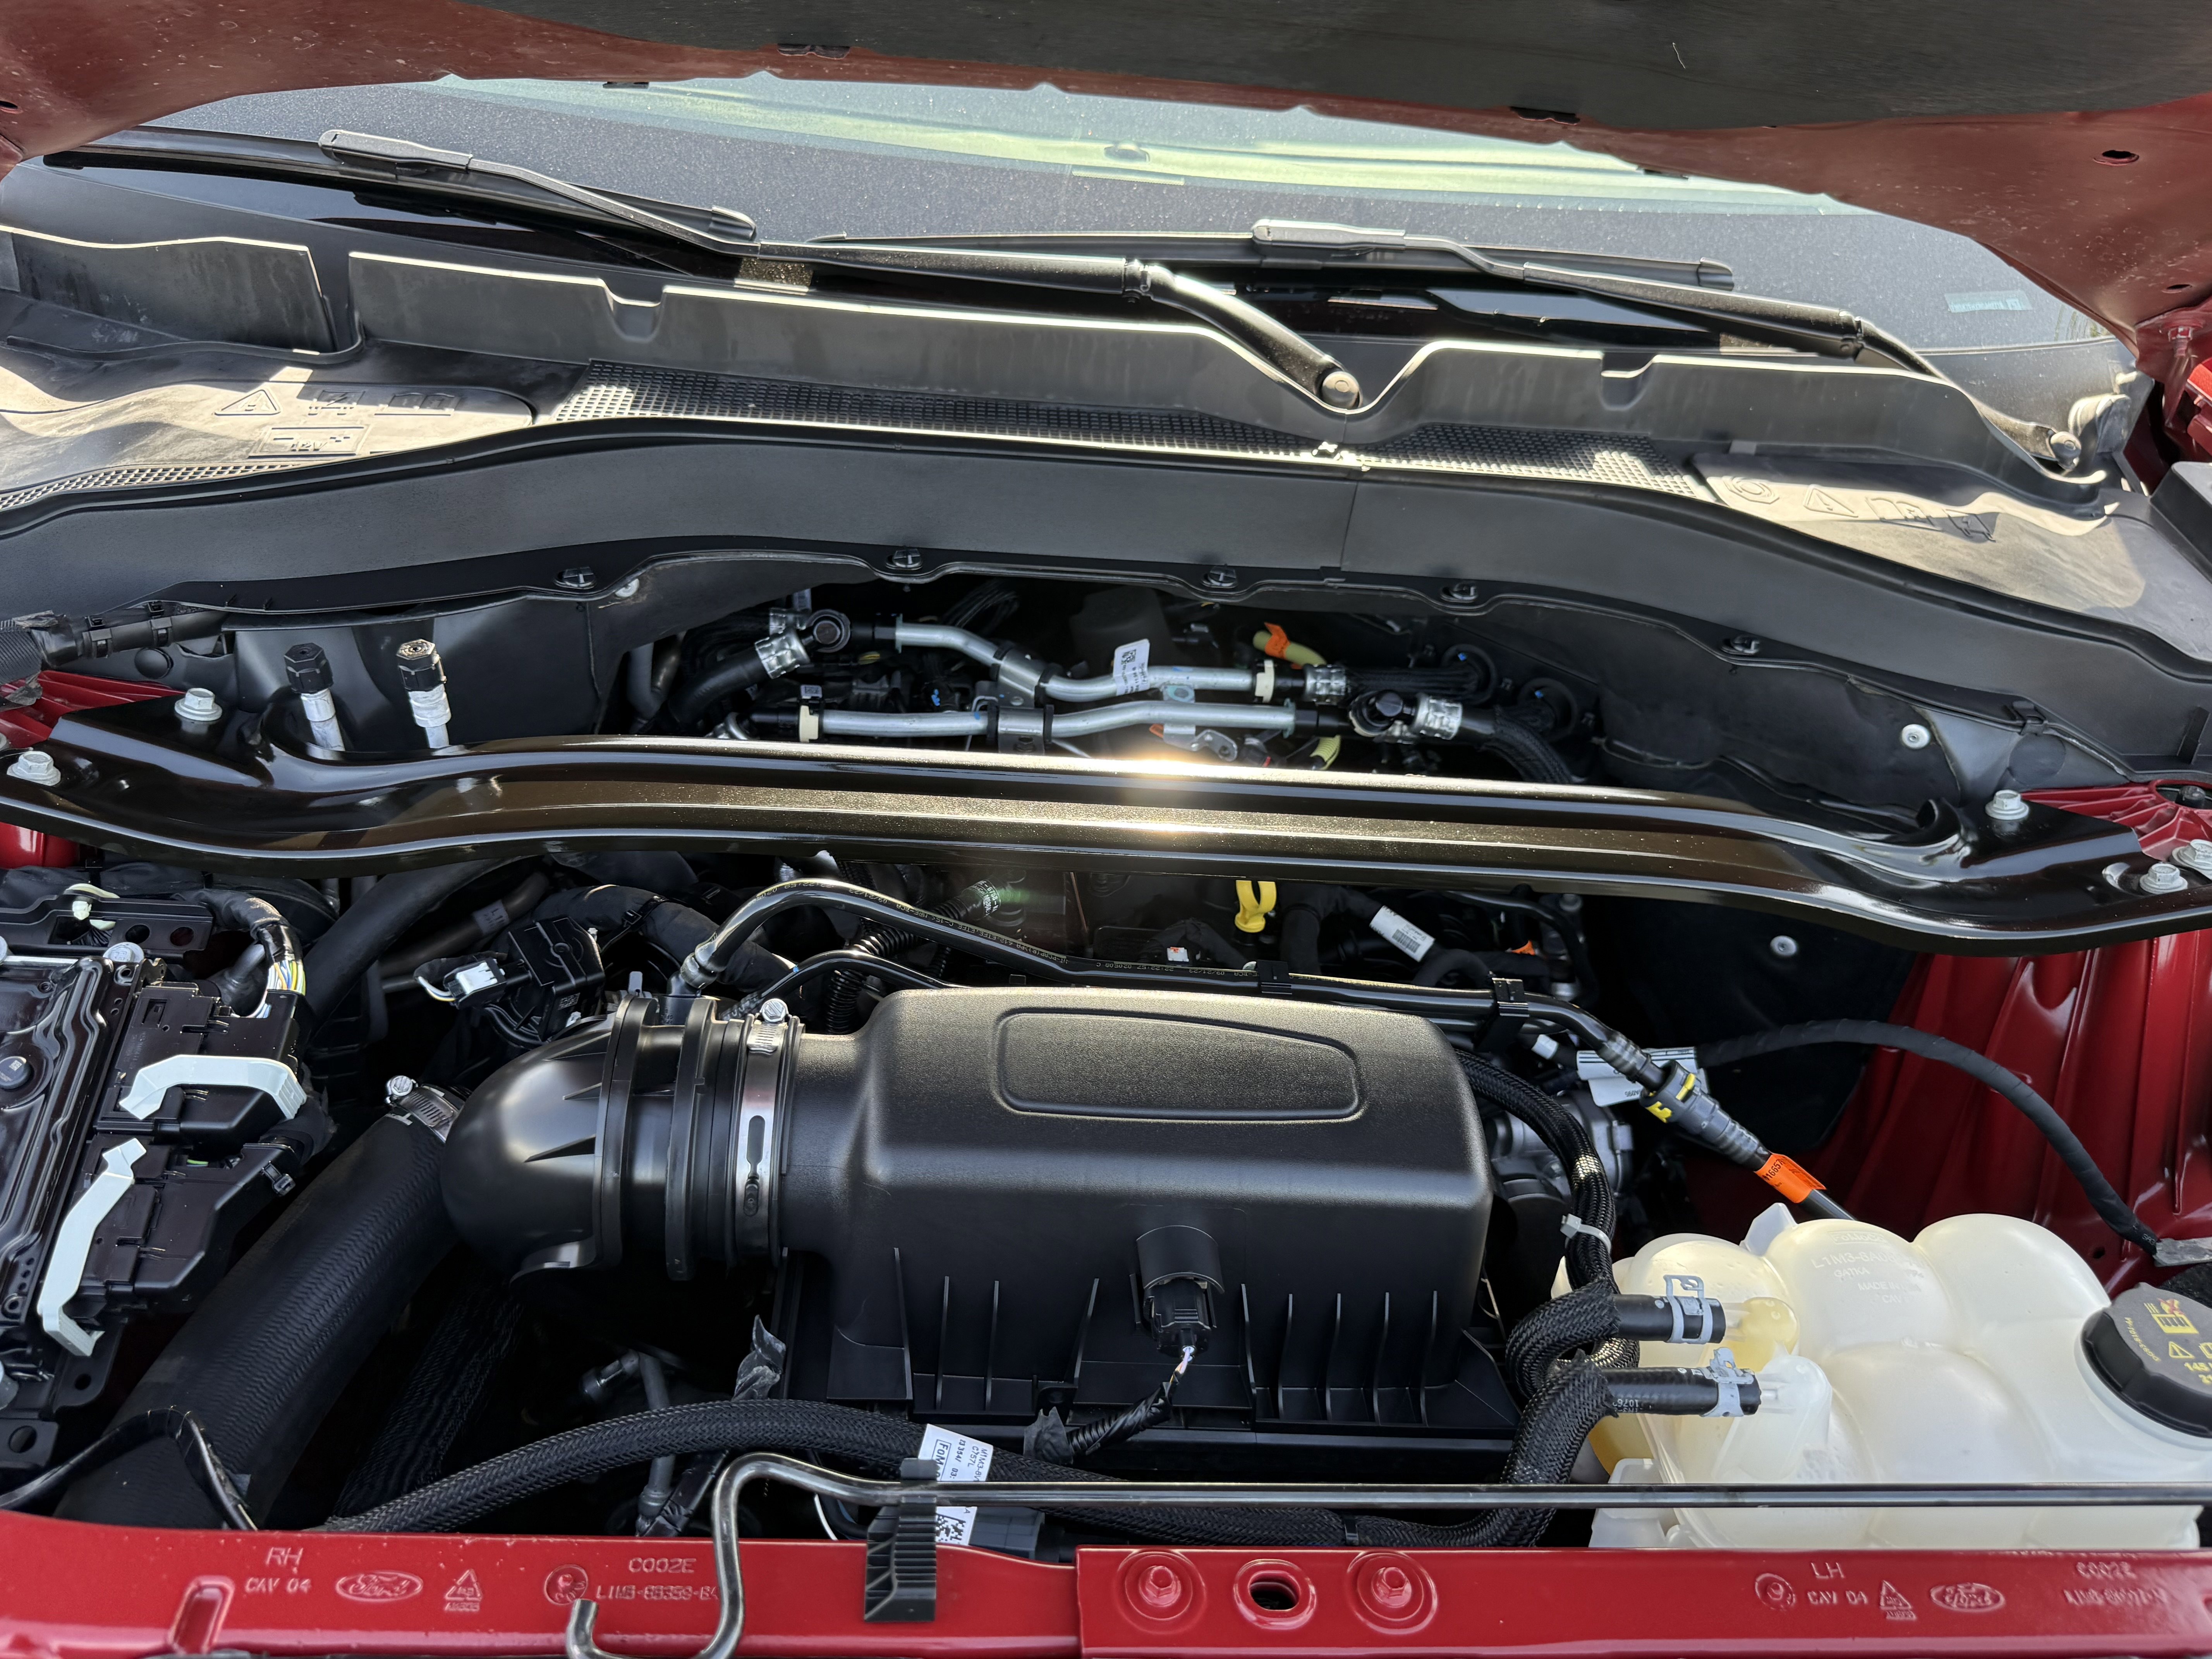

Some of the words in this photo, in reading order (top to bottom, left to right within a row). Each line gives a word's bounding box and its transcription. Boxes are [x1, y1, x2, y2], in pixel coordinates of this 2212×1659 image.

[1858, 1281, 1886, 1291] MADE
[967, 1446, 981, 1467] C757L
[265, 1547, 303, 1566] RH
[629, 1557, 697, 1573] C002E
[1810, 1562, 1845, 1579] LH
[245, 1577, 280, 1593] CAV
[287, 1578, 311, 1594] 04
[347, 1572, 412, 1598] Ford
[1807, 1590, 1838, 1605] CAV
[1846, 1590, 1868, 1605] 04
[1940, 1583, 1994, 1608] Ford
